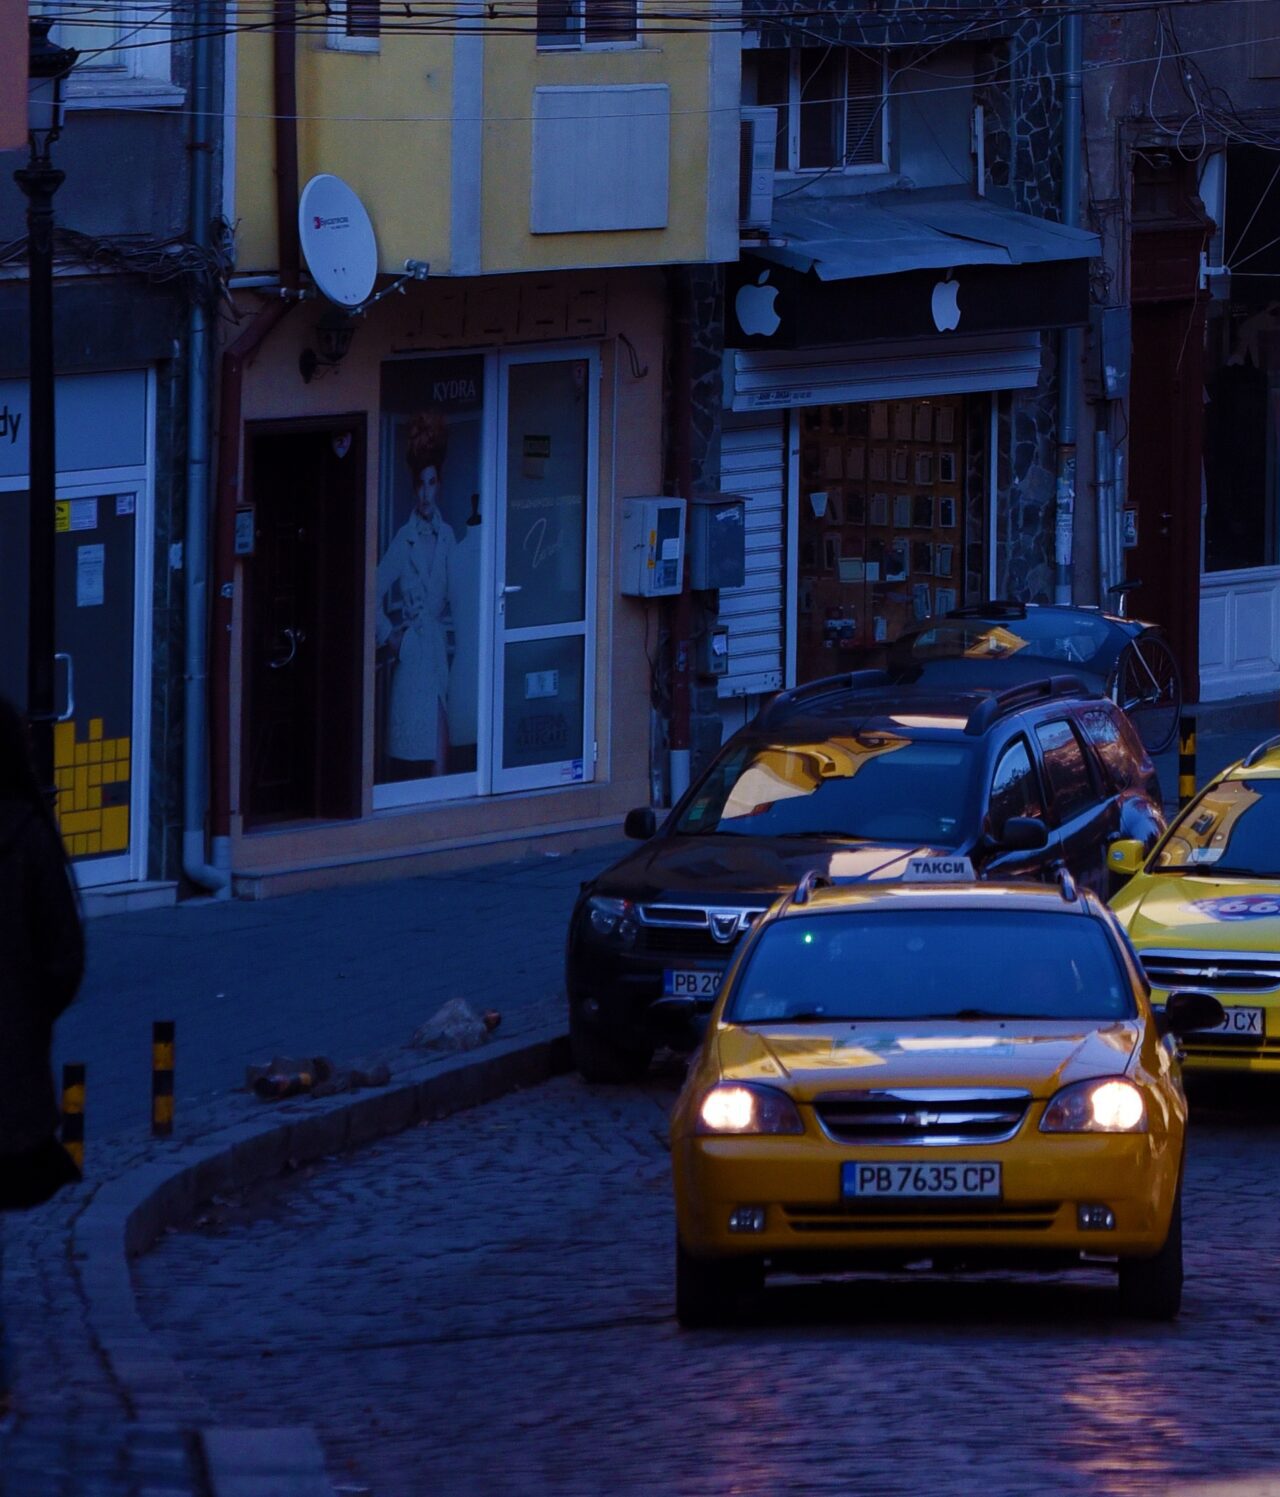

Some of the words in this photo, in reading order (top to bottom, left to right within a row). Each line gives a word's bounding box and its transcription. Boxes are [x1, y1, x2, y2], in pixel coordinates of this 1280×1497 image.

[433, 379, 477, 402] KYDRA
[913, 862, 965, 874] ТАКСИ
[896, 1167, 958, 1192] 7635
